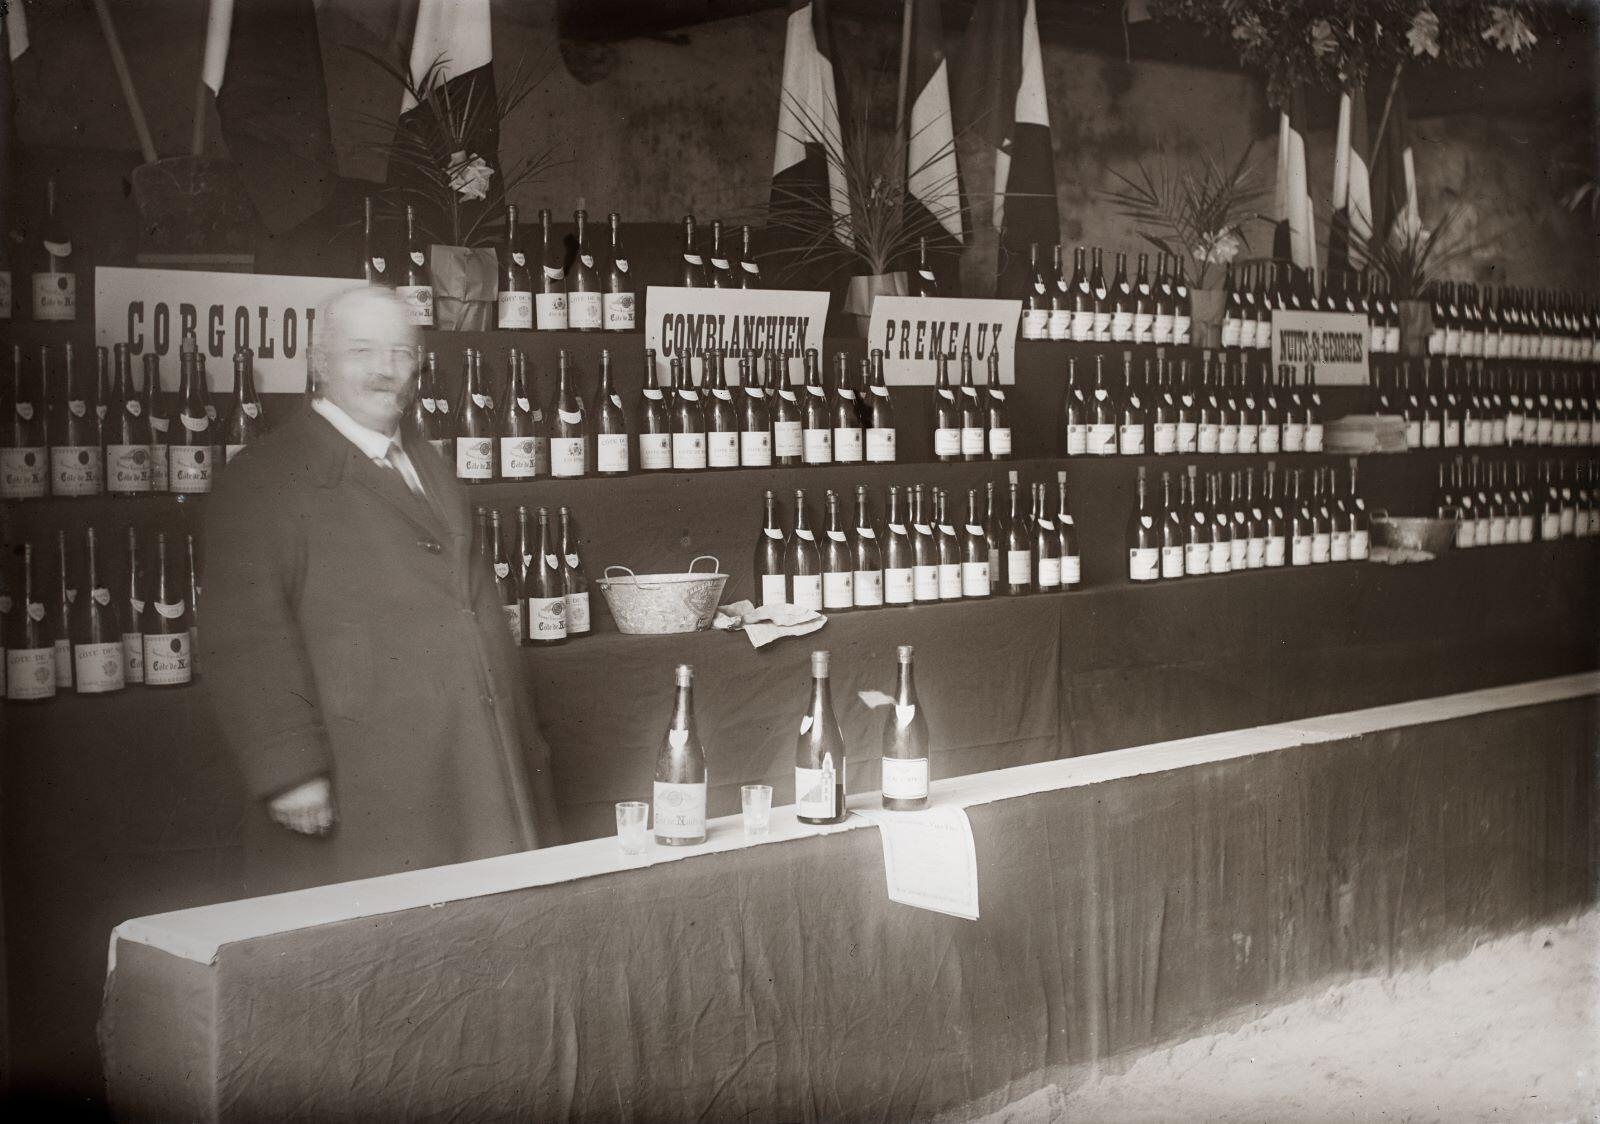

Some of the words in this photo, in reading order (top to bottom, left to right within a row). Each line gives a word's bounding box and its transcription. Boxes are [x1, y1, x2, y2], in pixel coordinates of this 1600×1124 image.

[128, 301, 316, 361] CORGOLOI
[662, 313, 809, 359] COMBLANCHIEN
[885, 319, 1003, 361] PREMEAUX
